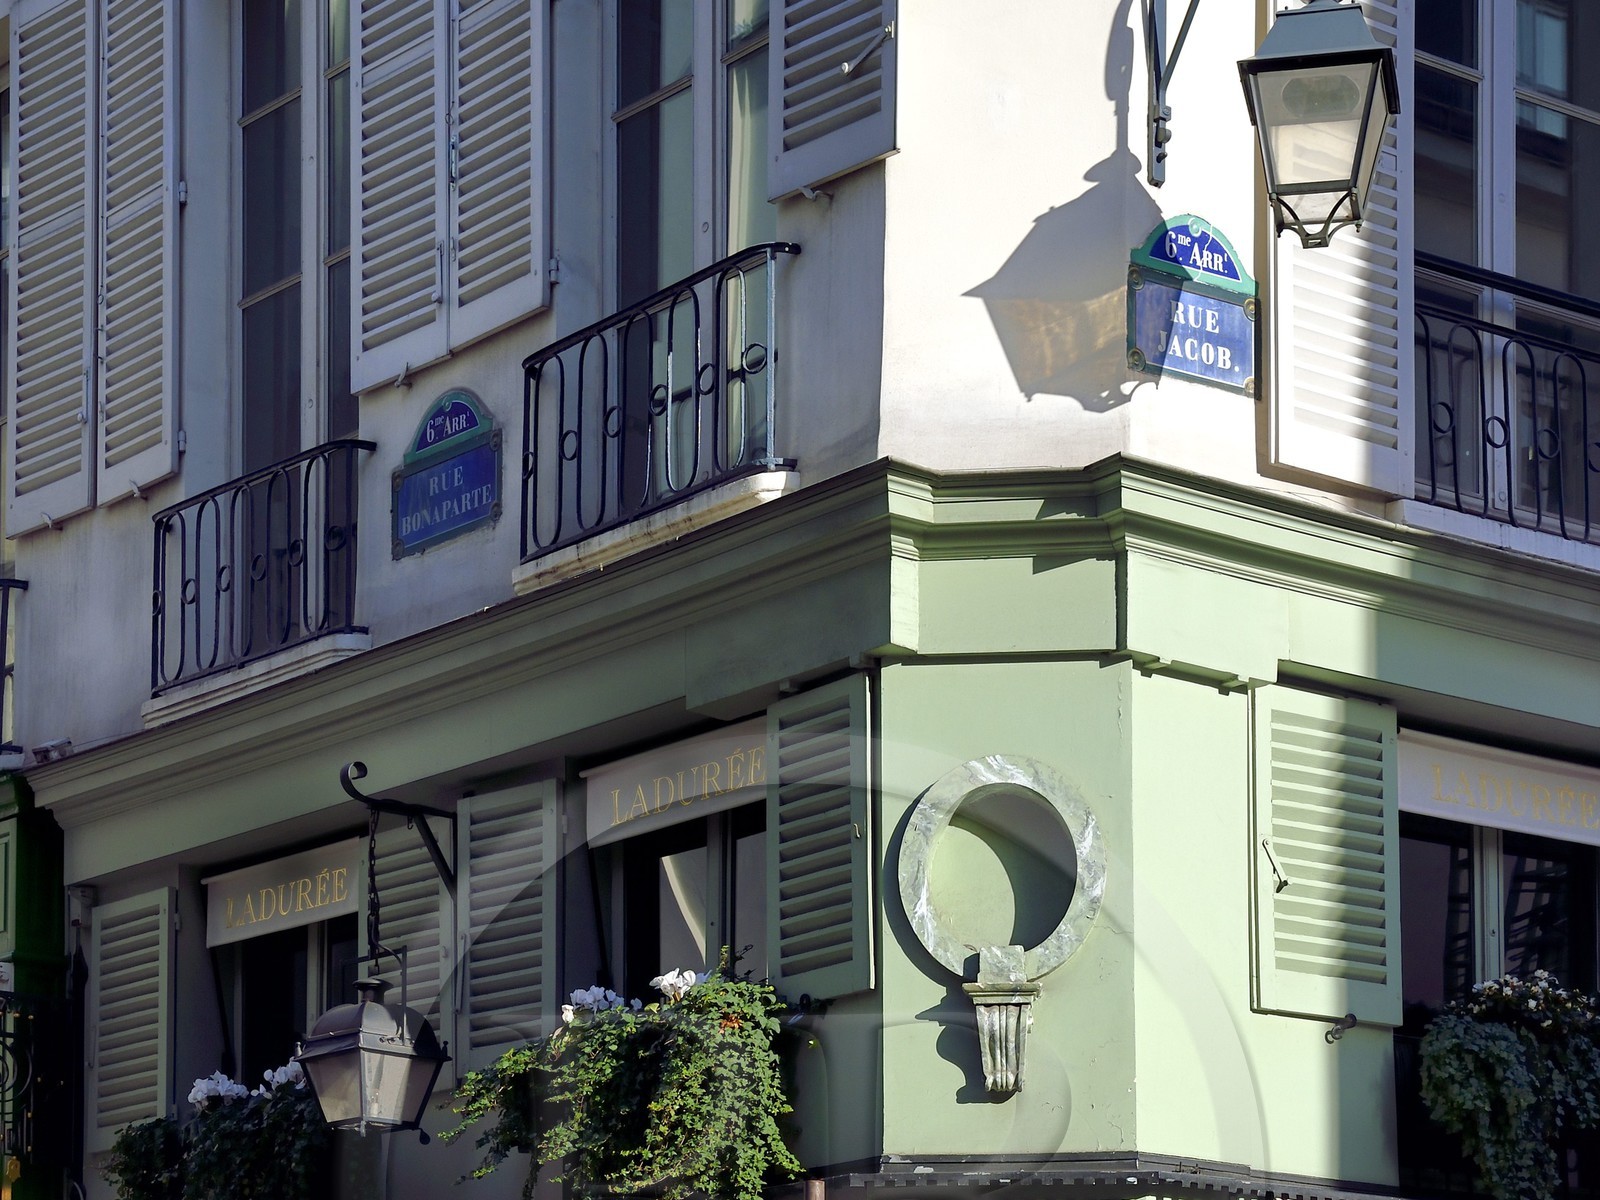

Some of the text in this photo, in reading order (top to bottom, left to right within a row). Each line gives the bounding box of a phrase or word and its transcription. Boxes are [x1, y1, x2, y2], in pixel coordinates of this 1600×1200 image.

[1169, 299, 1220, 334] RUE
[400, 483, 492, 537] BONAPARTE
[428, 465, 464, 497] RUE
[610, 744, 767, 827] LADURÉE
[1430, 763, 1600, 831] LADURÉE
[225, 867, 349, 929] LADURÉE
